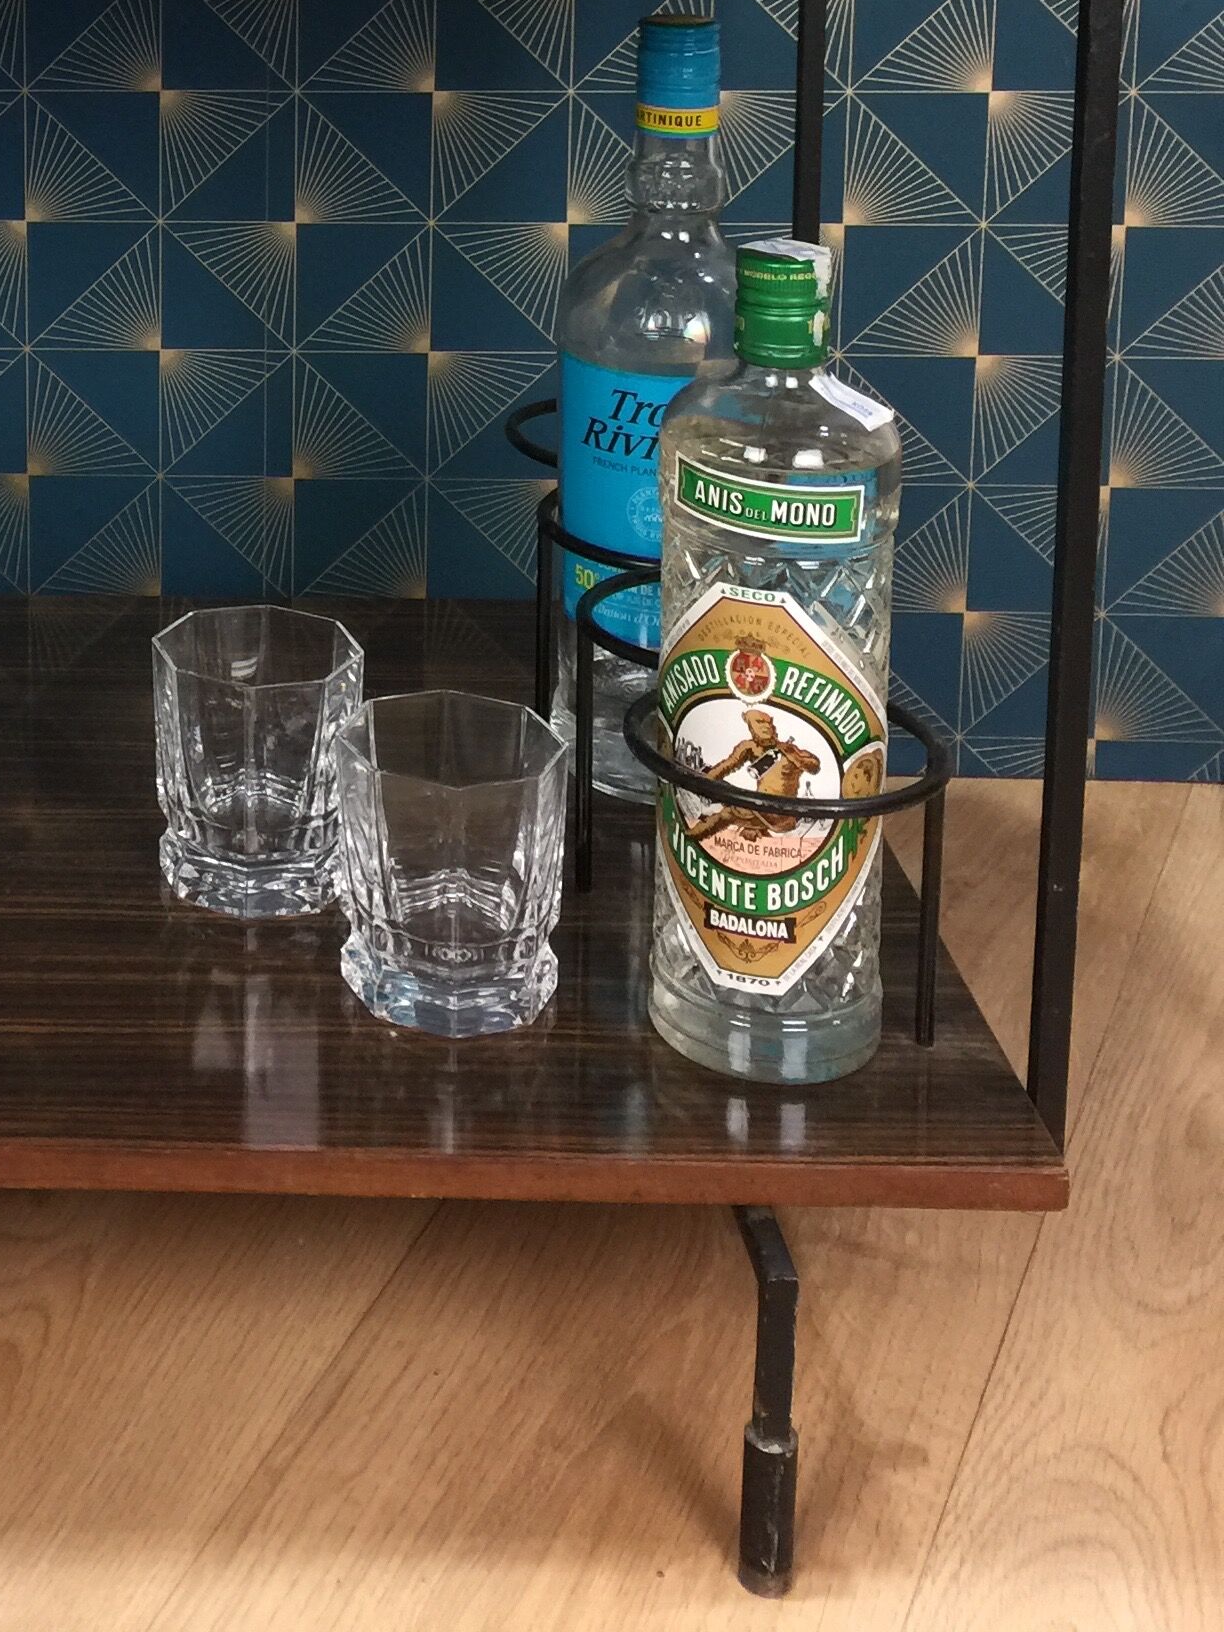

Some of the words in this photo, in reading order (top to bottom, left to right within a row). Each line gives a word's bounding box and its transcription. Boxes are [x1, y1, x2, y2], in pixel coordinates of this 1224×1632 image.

[694, 479, 744, 516] ANIS
[745, 506, 767, 521] DEL
[770, 499, 836, 527] MONO
[729, 587, 776, 603] SECO
[661, 653, 721, 715] ANISADO
[780, 666, 866, 746] REFINADO
[672, 811, 757, 911] VICENTE
[767, 835, 844, 912] BOSCH
[714, 835, 745, 853] MARCA
[747, 844, 760, 856] DE
[763, 846, 803, 859] FABRICA
[710, 908, 789, 939] BADALONA
[726, 973, 770, 987] 1870
